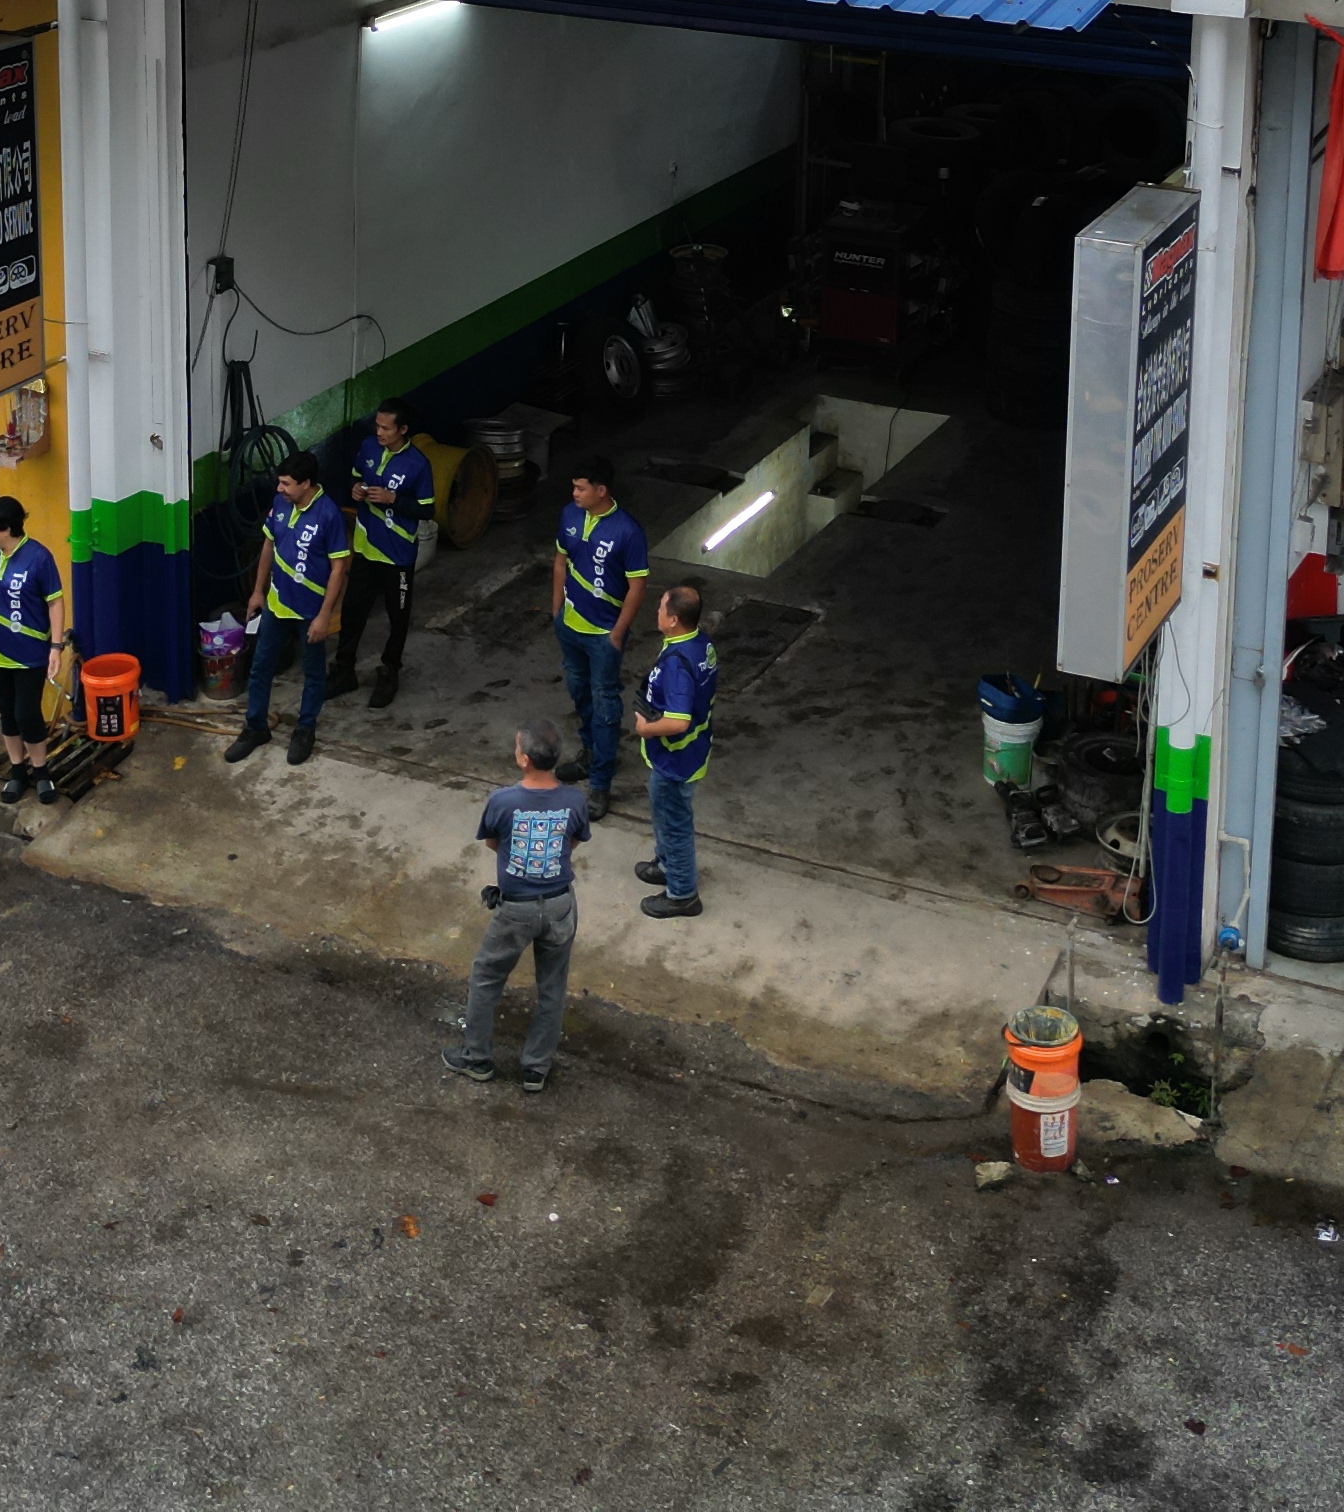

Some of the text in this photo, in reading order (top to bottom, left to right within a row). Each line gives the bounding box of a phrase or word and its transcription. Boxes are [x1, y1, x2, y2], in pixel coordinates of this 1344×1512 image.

[4, 105, 27, 125] lead
[4, 199, 34, 243] SERVICE
[834, 251, 886, 265] HUNTER
[1126, 560, 1179, 641] CENTRE
